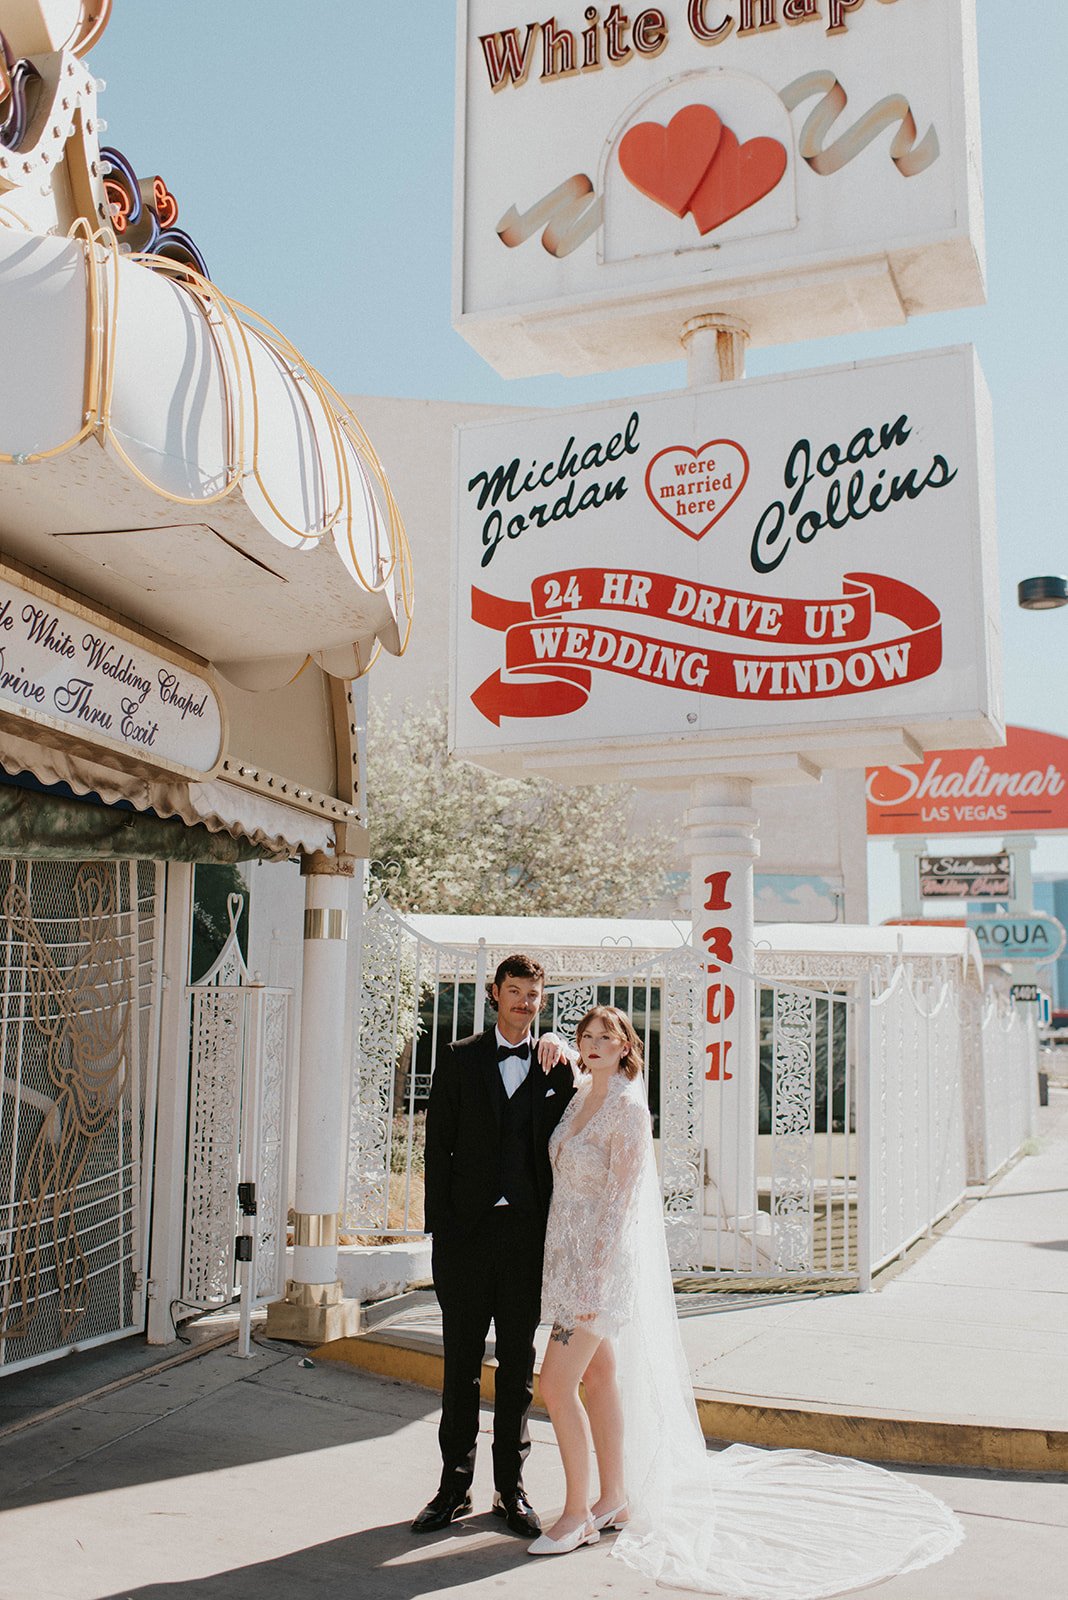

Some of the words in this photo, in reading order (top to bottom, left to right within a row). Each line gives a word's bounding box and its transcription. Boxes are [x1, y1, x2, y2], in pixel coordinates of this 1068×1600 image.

[478, 6, 669, 93] White
[687, 0, 897, 47] Chap
[468, 411, 640, 511] Michael
[659, 474, 732, 499] married
[674, 457, 716, 476] were
[783, 414, 913, 515] Joan
[481, 475, 628, 567] Jordan
[676, 496, 716, 517] here
[750, 453, 959, 573] Collins
[544, 579, 583, 609] 24
[600, 573, 652, 608] HR
[668, 584, 783, 637] DRIVE
[804, 604, 856, 639] UP
[21, 604, 75, 659] White
[82, 634, 152, 704] Wedding
[158, 668, 209, 720] Chapel
[530, 628, 710, 687] WEDDING
[734, 642, 912, 696] WINDOW
[54, 678, 112, 730] Thru
[121, 697, 158, 746] Exit
[866, 755, 1065, 806] Shalimar
[921, 806, 950, 822] LAS
[953, 804, 1008, 822] VEGAS
[976, 924, 1049, 947] AQUA
[701, 871, 735, 1081] 1301
